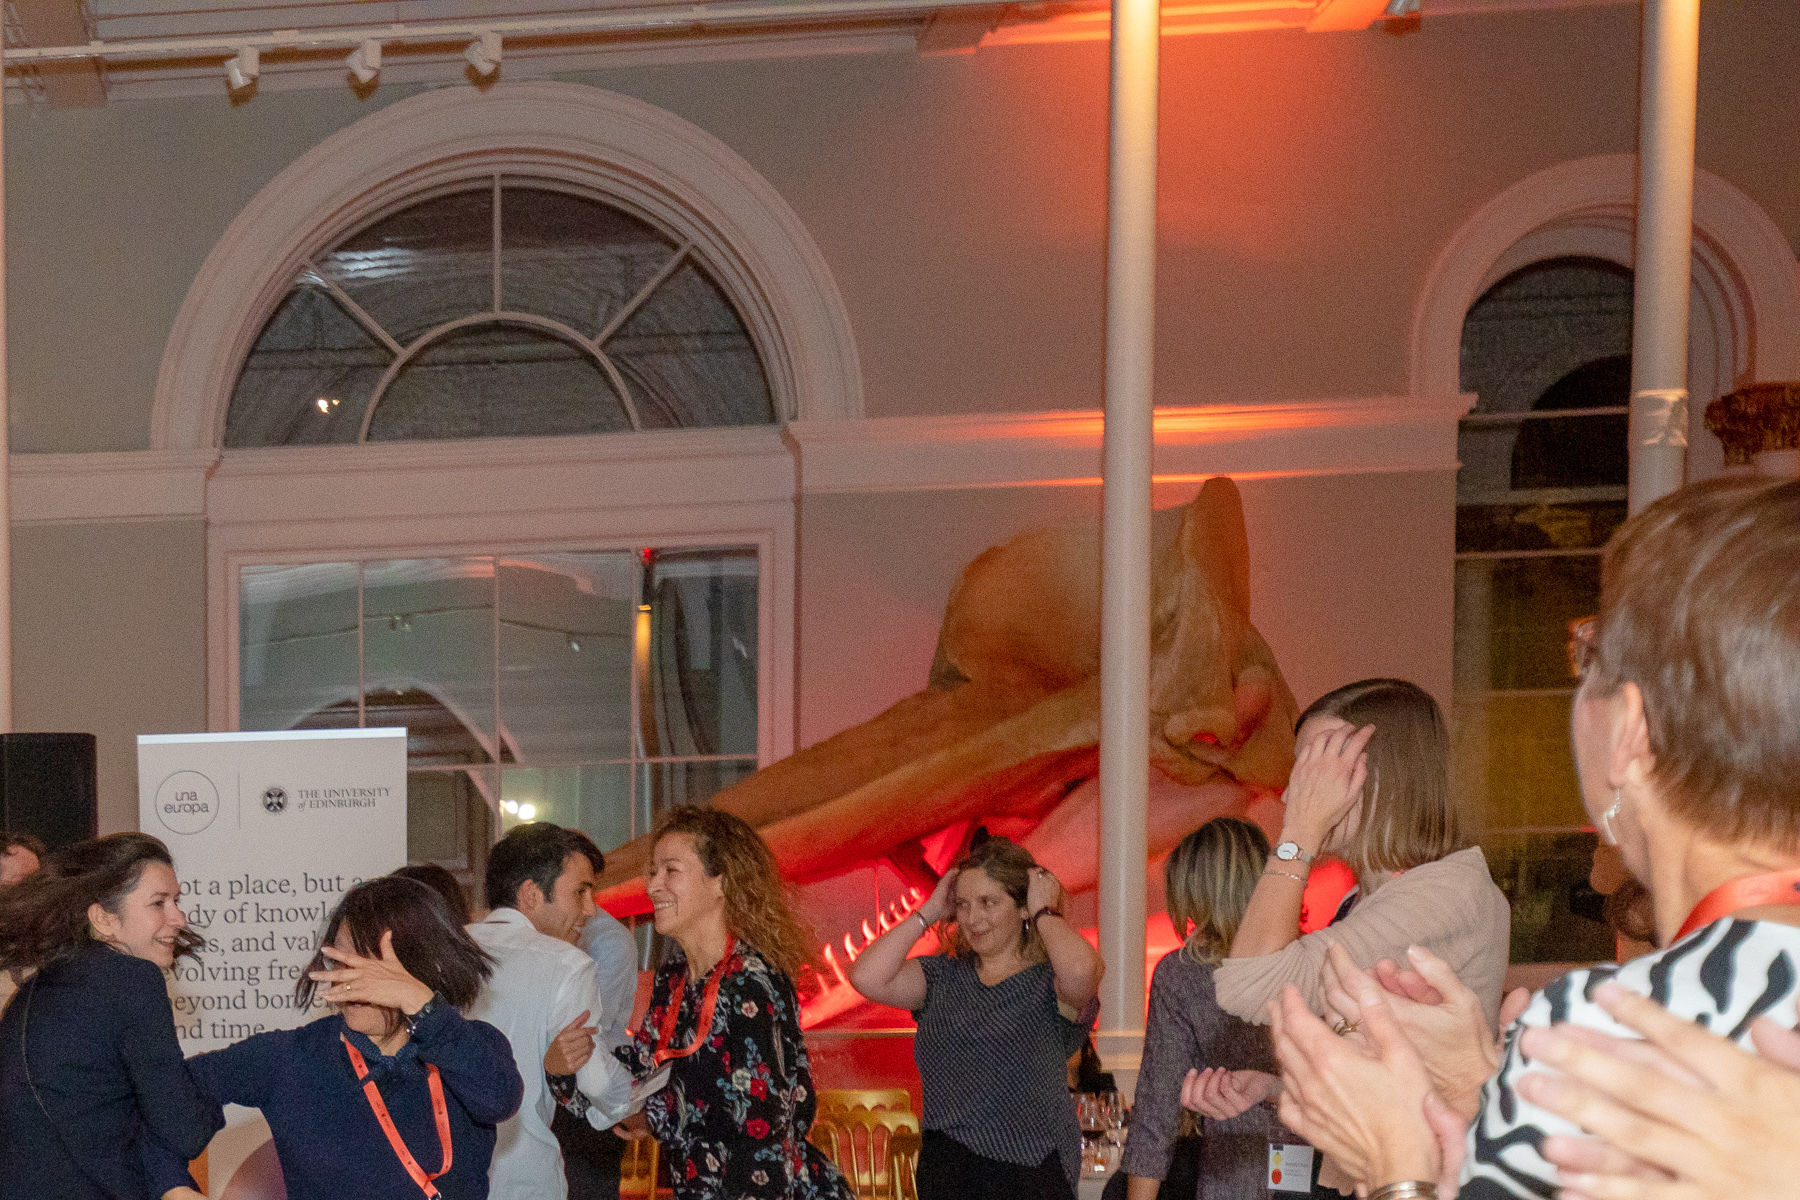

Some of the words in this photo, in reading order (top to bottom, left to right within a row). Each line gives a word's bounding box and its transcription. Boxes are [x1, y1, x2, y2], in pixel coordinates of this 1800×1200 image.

[175, 790, 198, 802] una
[298, 788, 320, 799] THE
[323, 786, 390, 799] UNIVERSITY
[164, 802, 210, 816] europa
[298, 801, 306, 812] of
[309, 798, 376, 809] EDINBURGH
[179, 879, 202, 896] ot
[208, 879, 221, 895] a
[229, 873, 297, 900] place,
[303, 872, 345, 893] but
[180, 903, 218, 929] dy
[224, 901, 249, 924] of
[255, 901, 335, 924] knowl
[232, 931, 276, 953] and
[282, 930, 320, 951] val
[268, 959, 301, 980] fre
[175, 989, 248, 1016] eyond
[175, 1018, 203, 1040] nd
